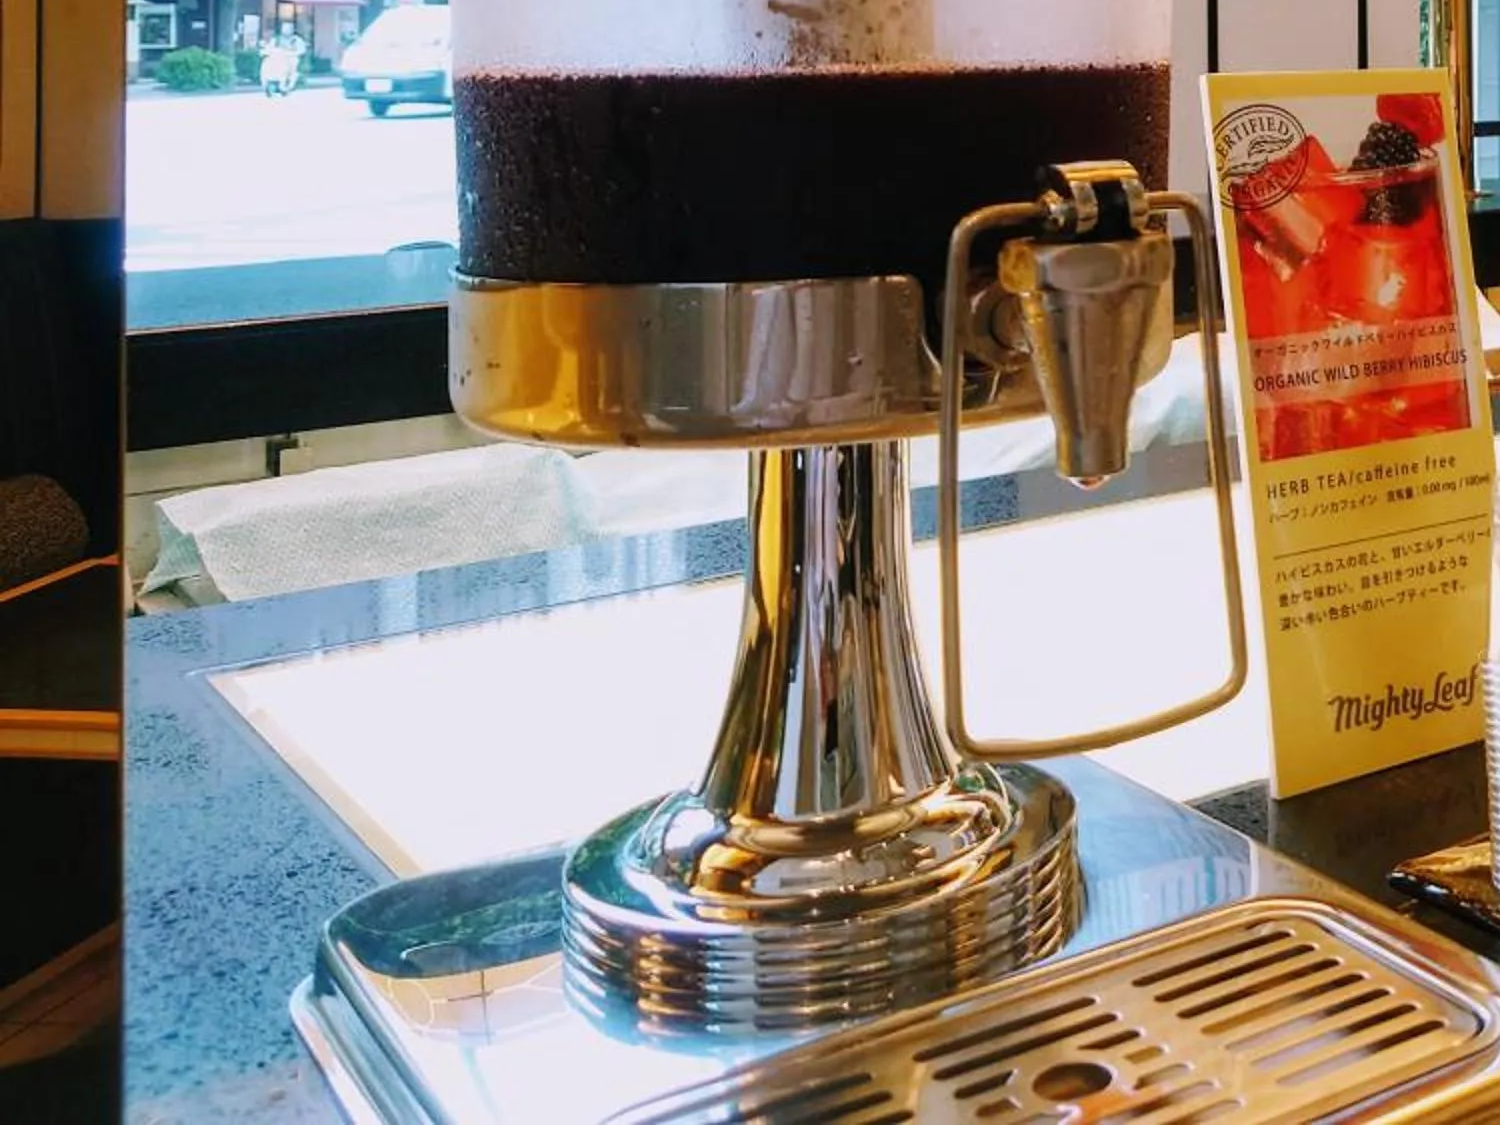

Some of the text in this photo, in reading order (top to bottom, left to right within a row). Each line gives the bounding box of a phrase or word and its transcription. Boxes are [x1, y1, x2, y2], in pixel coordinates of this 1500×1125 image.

[1254, 349, 1468, 392] ORGANIC WILD BERRY HIBISCUS
[1267, 478, 1310, 499] HERB
[1425, 455, 1457, 472] free
[1328, 664, 1479, 733] Mighty Leaf
